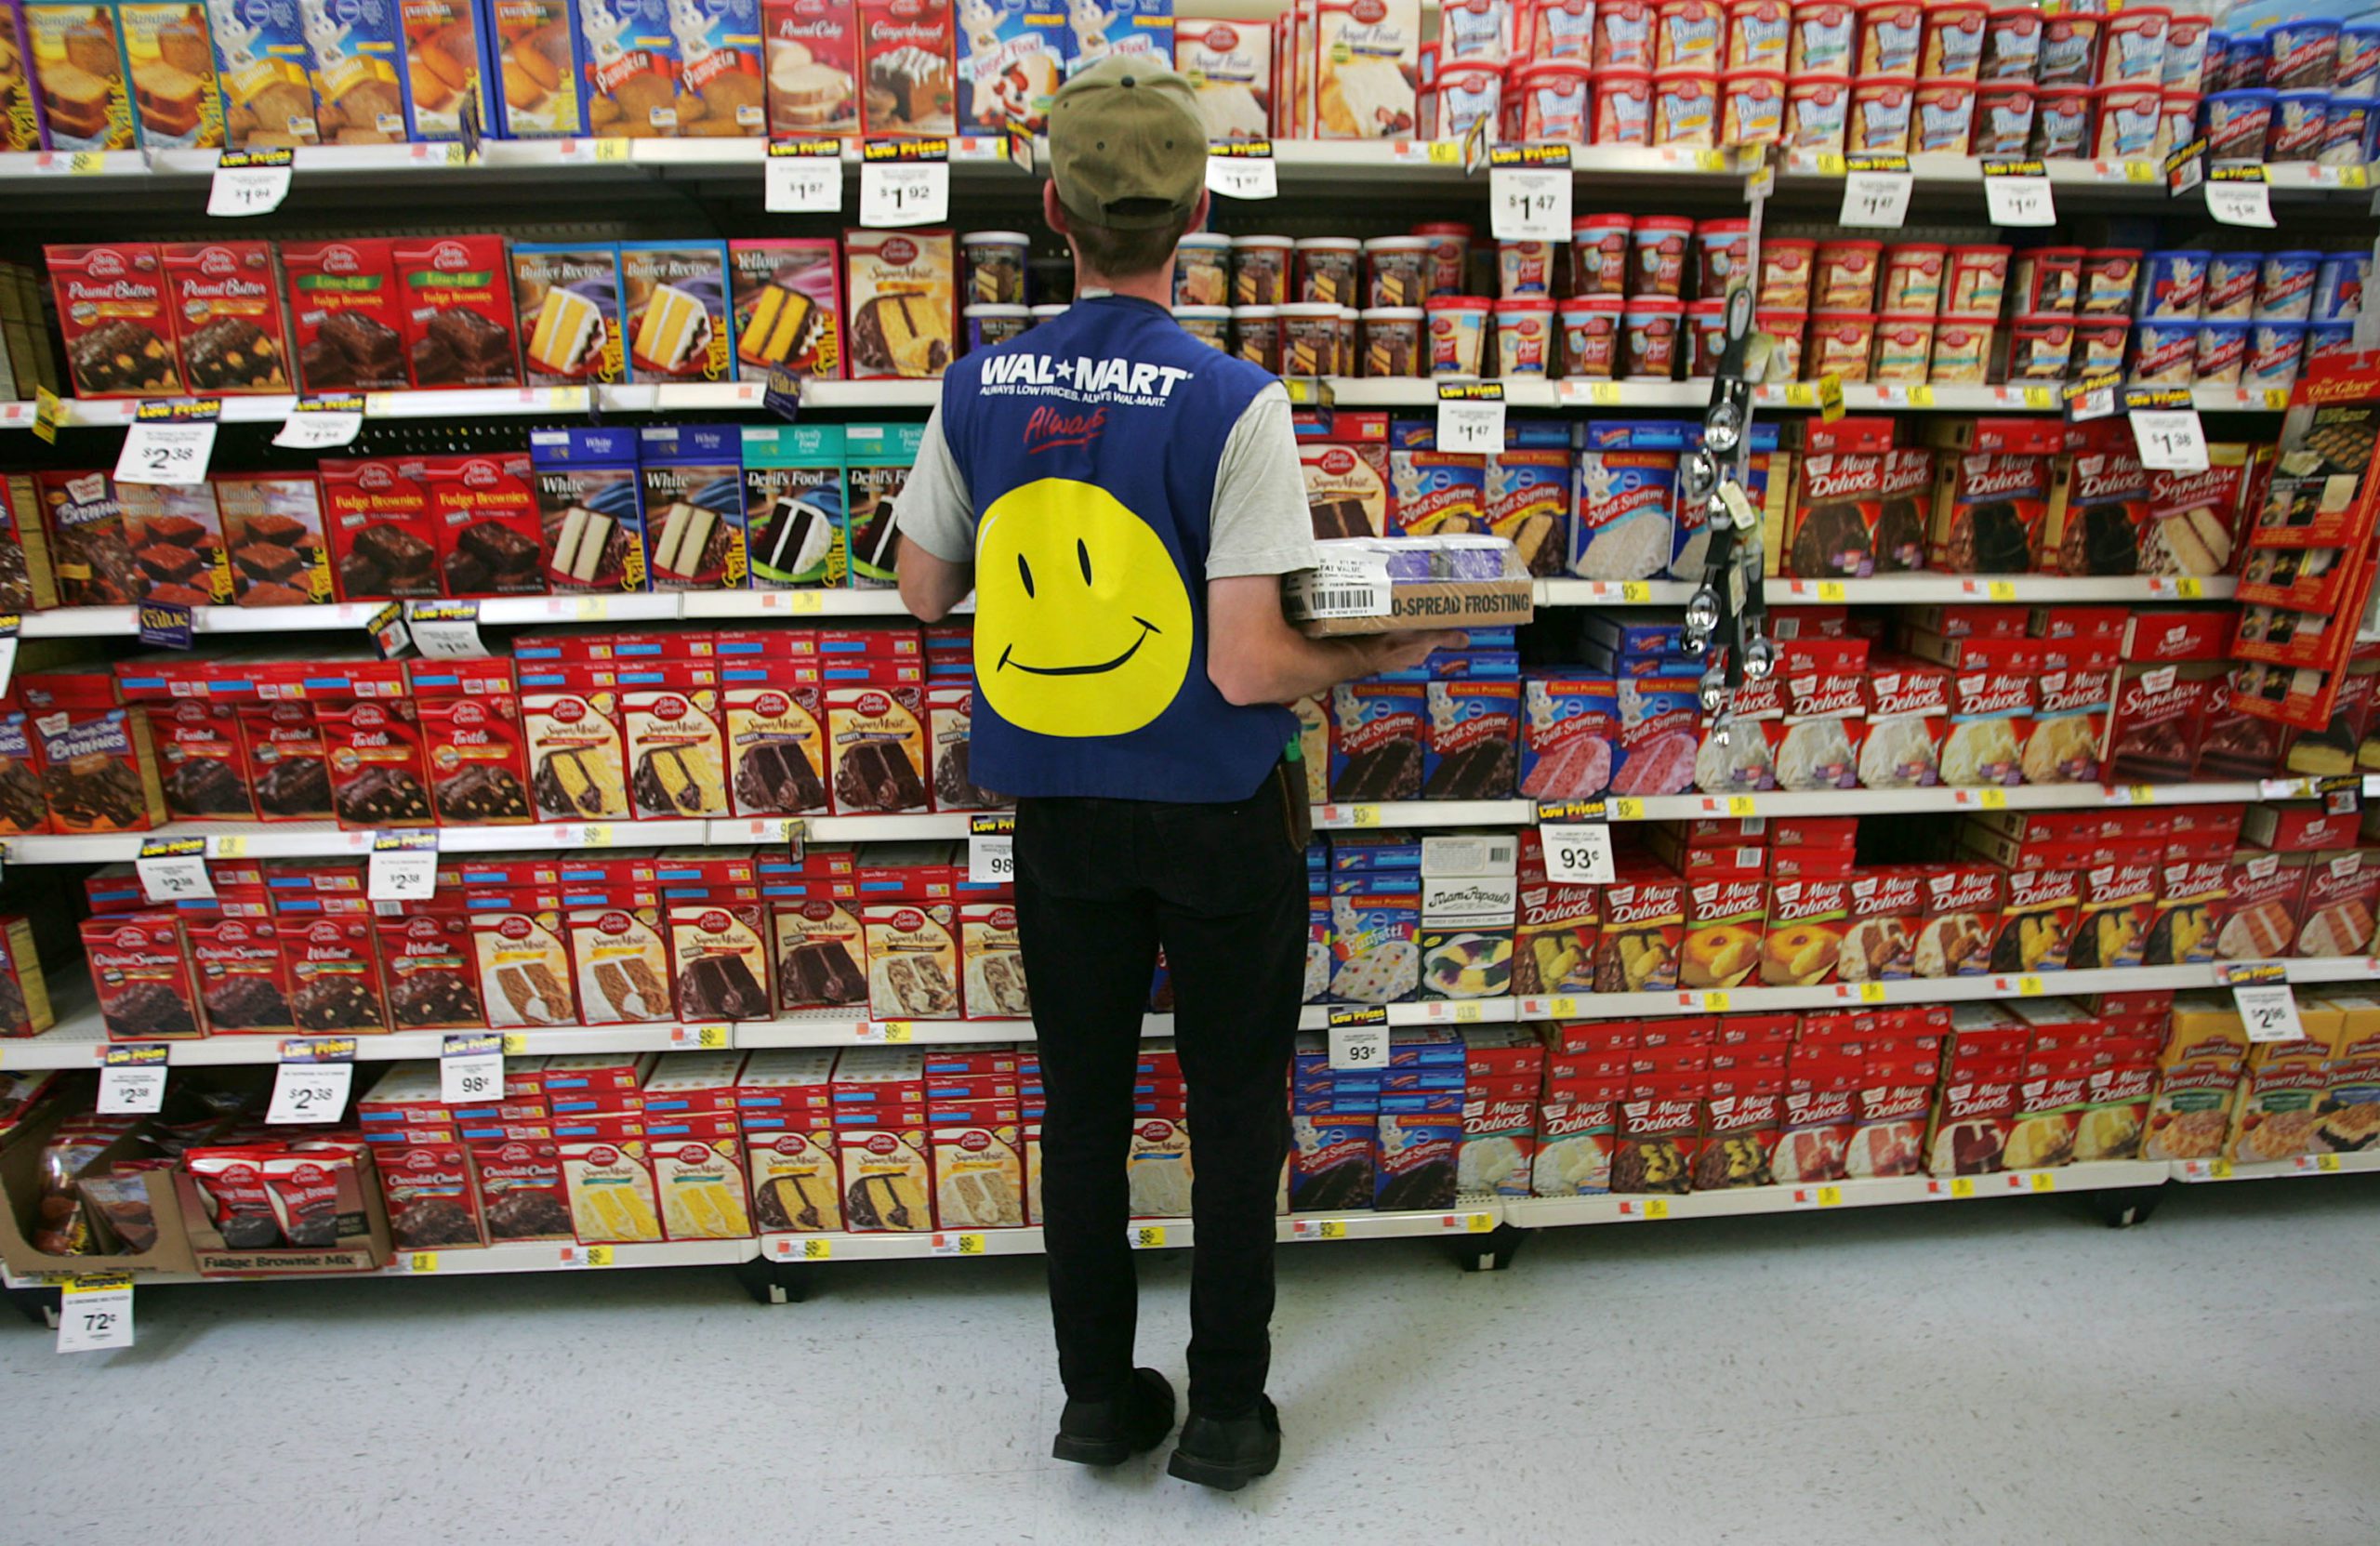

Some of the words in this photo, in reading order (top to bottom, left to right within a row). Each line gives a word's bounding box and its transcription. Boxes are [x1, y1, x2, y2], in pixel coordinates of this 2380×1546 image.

[779, 19, 814, 38] Pound
[815, 20, 843, 39] Cake
[872, 20, 945, 41] Gingerbread
[973, 44, 1007, 77] Angel
[1007, 35, 1043, 59] Food
[595, 52, 649, 93] Pumpkin
[681, 49, 738, 92] Pumpkin
[864, 142, 898, 160] Low
[900, 139, 947, 158] Prices
[1231, 142, 1270, 157] Prices
[1490, 148, 1523, 166] Low
[1524, 144, 1569, 164] Prices
[627, 261, 665, 277] Butter
[668, 261, 711, 278] Recipe
[736, 253, 781, 272] Yellow
[520, 265, 560, 280] Butter
[562, 264, 604, 281] Recipe
[69, 282, 112, 299] Peanut
[113, 282, 157, 299] Butter
[183, 281, 226, 298] Peanut
[227, 281, 267, 297] Butter
[980, 385, 1015, 398] ALWAYS
[1016, 385, 1040, 397] LOW
[1040, 387, 1080, 403] PRICES.
[1082, 392, 1112, 405] ALWYS
[1113, 392, 1167, 409] WAL-MART.
[1440, 387, 1464, 399] Low
[1466, 383, 1503, 398] Prices
[138, 403, 170, 421] Low
[173, 400, 220, 417] Prices
[1024, 405, 1110, 455] Always
[1838, 455, 1881, 474] Moist
[1992, 453, 2036, 474] Moist
[542, 476, 585, 494] White
[646, 472, 690, 490] White
[747, 471, 789, 487] Devil's
[792, 471, 825, 486] Food
[851, 470, 891, 486] Devil's
[1809, 470, 1879, 497] Deluxe
[1968, 469, 2036, 496] Deluxe
[2080, 469, 2146, 496] Deluxe
[2151, 469, 2236, 504] Signature
[336, 496, 368, 510] Fudge
[371, 495, 422, 508] Brownies
[439, 493, 471, 507] Fudge
[473, 491, 529, 505] Brownies
[1397, 493, 1434, 521] Moist
[1434, 484, 1478, 508] Supreme
[1589, 495, 1623, 522] Moist
[1624, 486, 1668, 509] Supreme
[1466, 593, 1530, 614] FROSTING
[1822, 677, 1860, 695] Moist
[1989, 674, 2030, 693] Moist
[756, 702, 789, 715] Crocker
[760, 694, 782, 706] Betty
[857, 702, 892, 715] Crocker
[864, 694, 885, 705] Betty
[1794, 693, 1860, 716] Deluxe
[1963, 691, 2033, 715] Deluxe
[2120, 683, 2204, 717] Signature
[351, 732, 389, 747] Turtle
[453, 730, 489, 746] Turtle
[1342, 728, 1378, 753] Moist
[1373, 716, 1416, 736] Supreme
[1435, 728, 1469, 753] Moist
[1467, 716, 1510, 736] Supreme
[46, 734, 126, 760] Brownies
[1539, 805, 1565, 819] Low
[1567, 799, 1606, 816] Prices
[1561, 848, 1600, 869] 93¢
[2232, 868, 2303, 897] Signature
[2309, 870, 2380, 898] Signature
[1554, 886, 1595, 905] Moist
[1640, 884, 1680, 903] Moist
[507, 913, 525, 924] Betty
[1527, 901, 1593, 924] Deluxe
[1613, 899, 1680, 924] Deluxe
[501, 921, 531, 933] Crocker
[1345, 923, 1405, 958] Funfetti
[308, 947, 351, 962] Walnut
[404, 944, 450, 960] Walnut
[1329, 1011, 1351, 1025] Low
[1353, 1007, 1386, 1023] Prices
[283, 1041, 314, 1057] Low
[315, 1037, 357, 1054] Prices
[1350, 1046, 1376, 1062] 93¢
[462, 1077, 490, 1094] 98¢
[2162, 1072, 2202, 1090] Dessert
[1491, 1103, 1527, 1117] Moist
[1143, 1129, 1173, 1140] Crocker
[1152, 1121, 1171, 1132] Betty
[1464, 1116, 1528, 1134] Deluxe
[959, 1140, 989, 1153] Crocker
[965, 1132, 985, 1143] Betty
[388, 1173, 431, 1186] Chocolate
[433, 1172, 464, 1185] Chunk
[483, 1166, 526, 1180] Chocolate
[204, 1256, 251, 1272] Fudge
[256, 1252, 323, 1269] Brownie
[327, 1251, 355, 1266] Mix
[83, 1313, 117, 1331] 72¢
